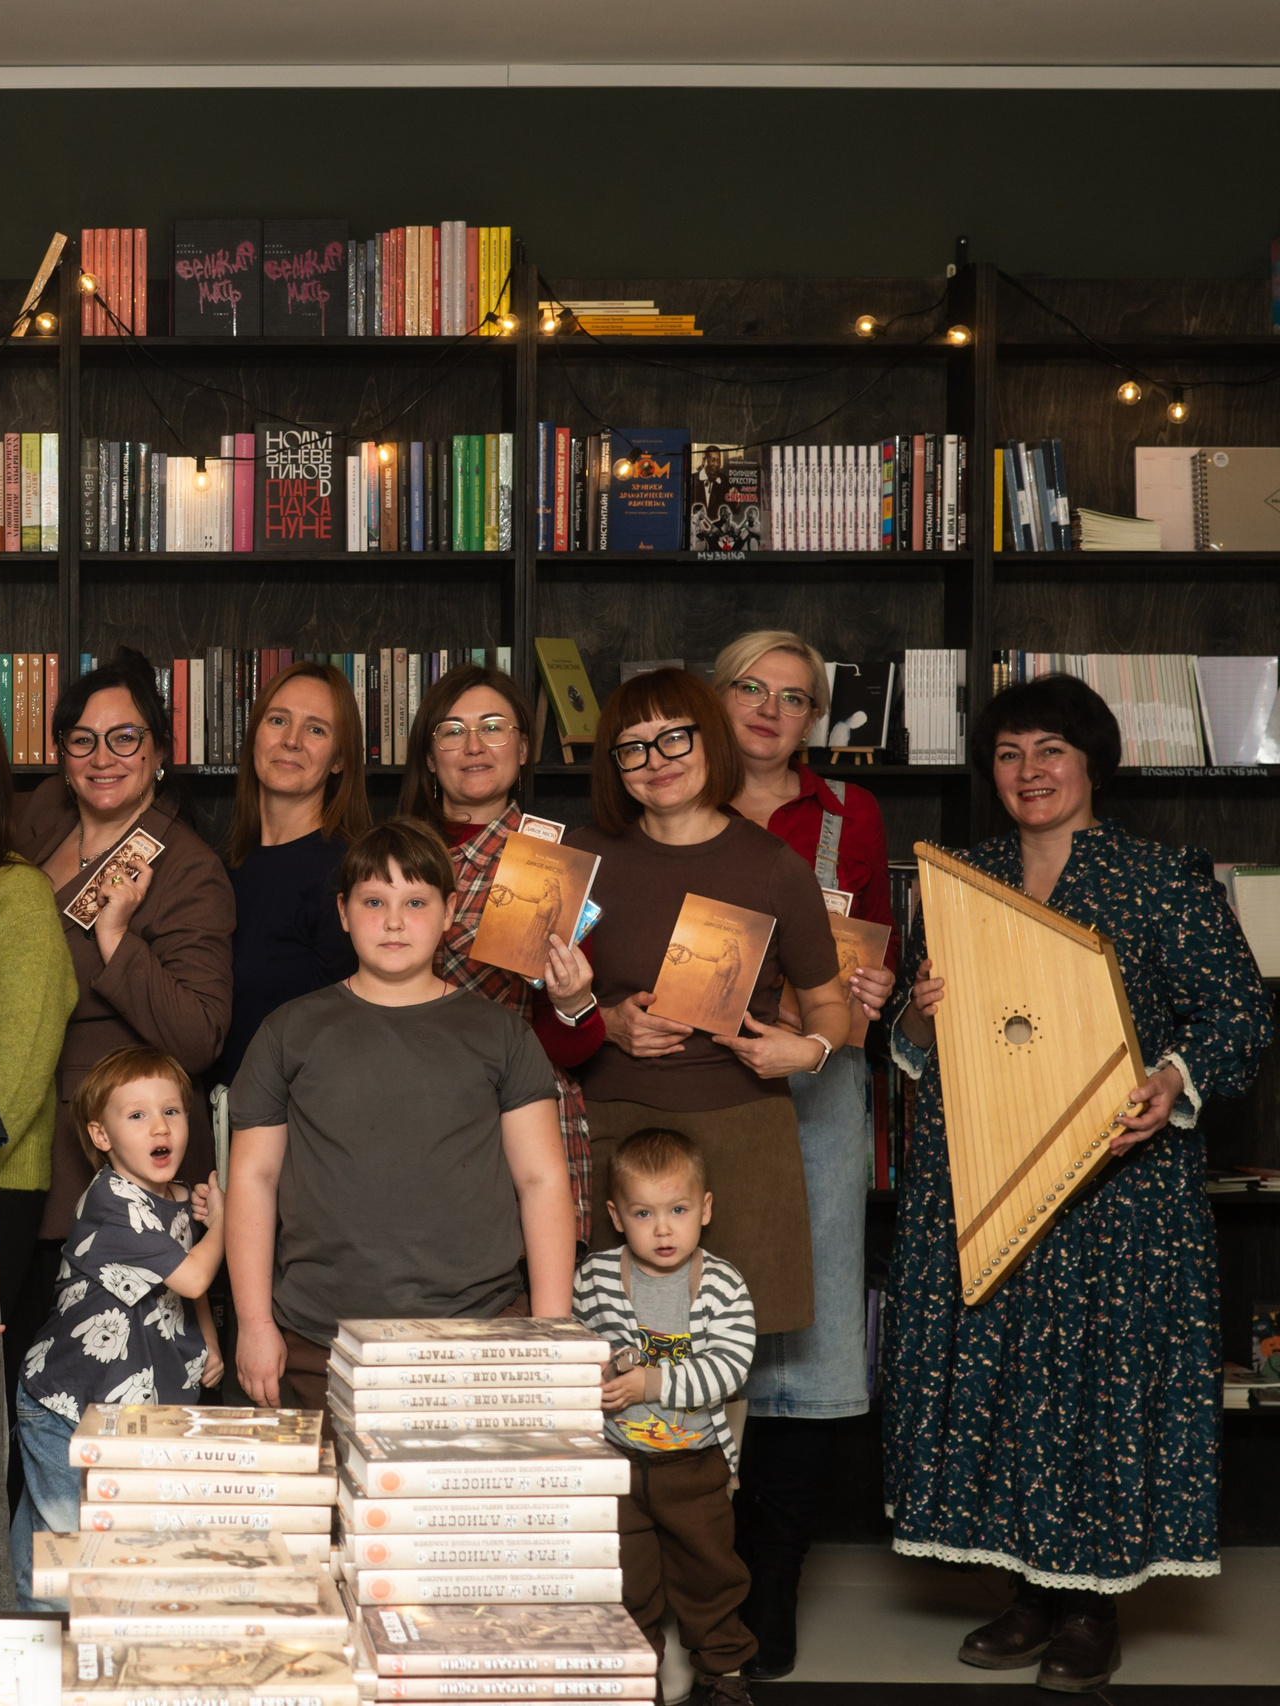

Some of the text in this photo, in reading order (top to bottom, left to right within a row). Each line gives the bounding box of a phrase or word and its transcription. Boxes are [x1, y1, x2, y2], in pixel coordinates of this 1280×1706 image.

[176, 240, 255, 280] ВЕЛИКАЯ
[264, 241, 344, 281] ВЕЛИКАЯ
[198, 279, 242, 312] МАТЬ
[287, 279, 330, 312] МАТЬ
[265, 430, 333, 449] НОАМ
[265, 449, 332, 465] ВЕНЕВЕ
[900, 441, 908, 474] Высоцкий
[265, 464, 332, 480] ТИНОВ
[729, 469, 758, 478] БОЛЬШИЕ
[265, 479, 320, 497] ПЛАН
[631, 483, 663, 491] ХРОНИКИ
[729, 477, 758, 485] ОРКЕСТРЫ
[724, 492, 758, 503] СВИНГА
[265, 497, 332, 516] НАКА
[600, 493, 608, 550] КОНСТАНТАЙН
[925, 493, 933, 550] КОНСТАНТАЙН
[947, 503, 955, 535] ROCK ART
[265, 516, 332, 539] НУНЕ
[697, 551, 746, 560] МУЗЫКА
[524, 826, 557, 839] ДИКОЕ МЕСТО
[525, 859, 564, 875] ДИКОЕ МЕСТО
[831, 899, 846, 907] МЕСТО
[703, 920, 743, 936] ДИКОЕ МЕСТО
[842, 937, 860, 946] МЕСТО
[407, 1345, 561, 1361] ТЫСЯЧА ОДНА СТРАСТЬ
[398, 1369, 553, 1385] ТЫСЯЧА ОДНА СТРАСТЬ
[399, 1392, 555, 1408] ТЫСЯЧА ОДНА СТРАСТЬ
[400, 1415, 556, 1431] ТЫСЯЧА ОДНА СТРАСТЬ
[180, 1450, 259, 1468] ПАЛАТА
[518, 1465, 584, 1473] ФАНТАСТИЧЕСКИЕ
[427, 1475, 585, 1492] ГРАФ КАЛИОСТРО
[199, 1483, 278, 1501] ПАЛАТА
[193, 1512, 272, 1530] ПАЛАТА
[414, 1513, 571, 1529] ГРАФ КАЛИОСТРО
[414, 1549, 573, 1565] ГРАФ КАЛИОСТРО
[418, 1584, 576, 1600] ГРАФ КАЛИОСТРО
[484, 1657, 538, 1670] НАРОДОВ
[554, 1657, 625, 1671] СКАЗКИ
[483, 1681, 537, 1694] НАРОДОВ
[552, 1681, 623, 1695] СКАЗКИ
